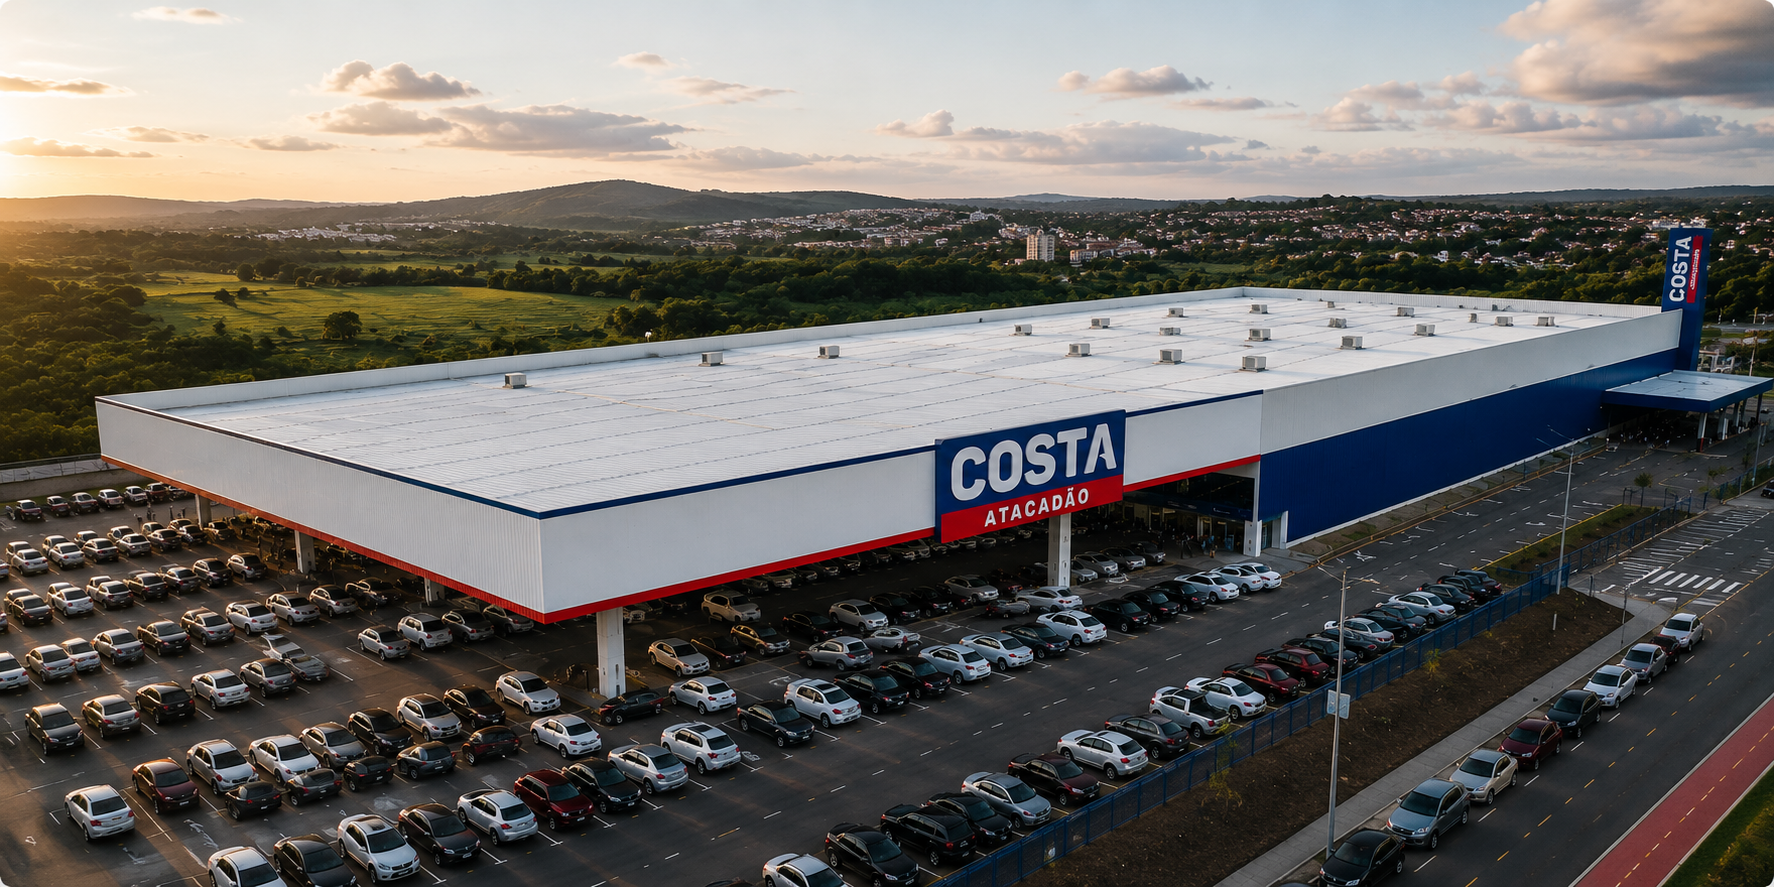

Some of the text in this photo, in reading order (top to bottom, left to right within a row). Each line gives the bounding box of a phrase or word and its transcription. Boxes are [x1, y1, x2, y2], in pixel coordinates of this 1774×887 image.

[1668, 236, 1692, 302] COSTA
[951, 423, 1117, 501] COSTA
[984, 487, 1089, 527] ATACADÃO
